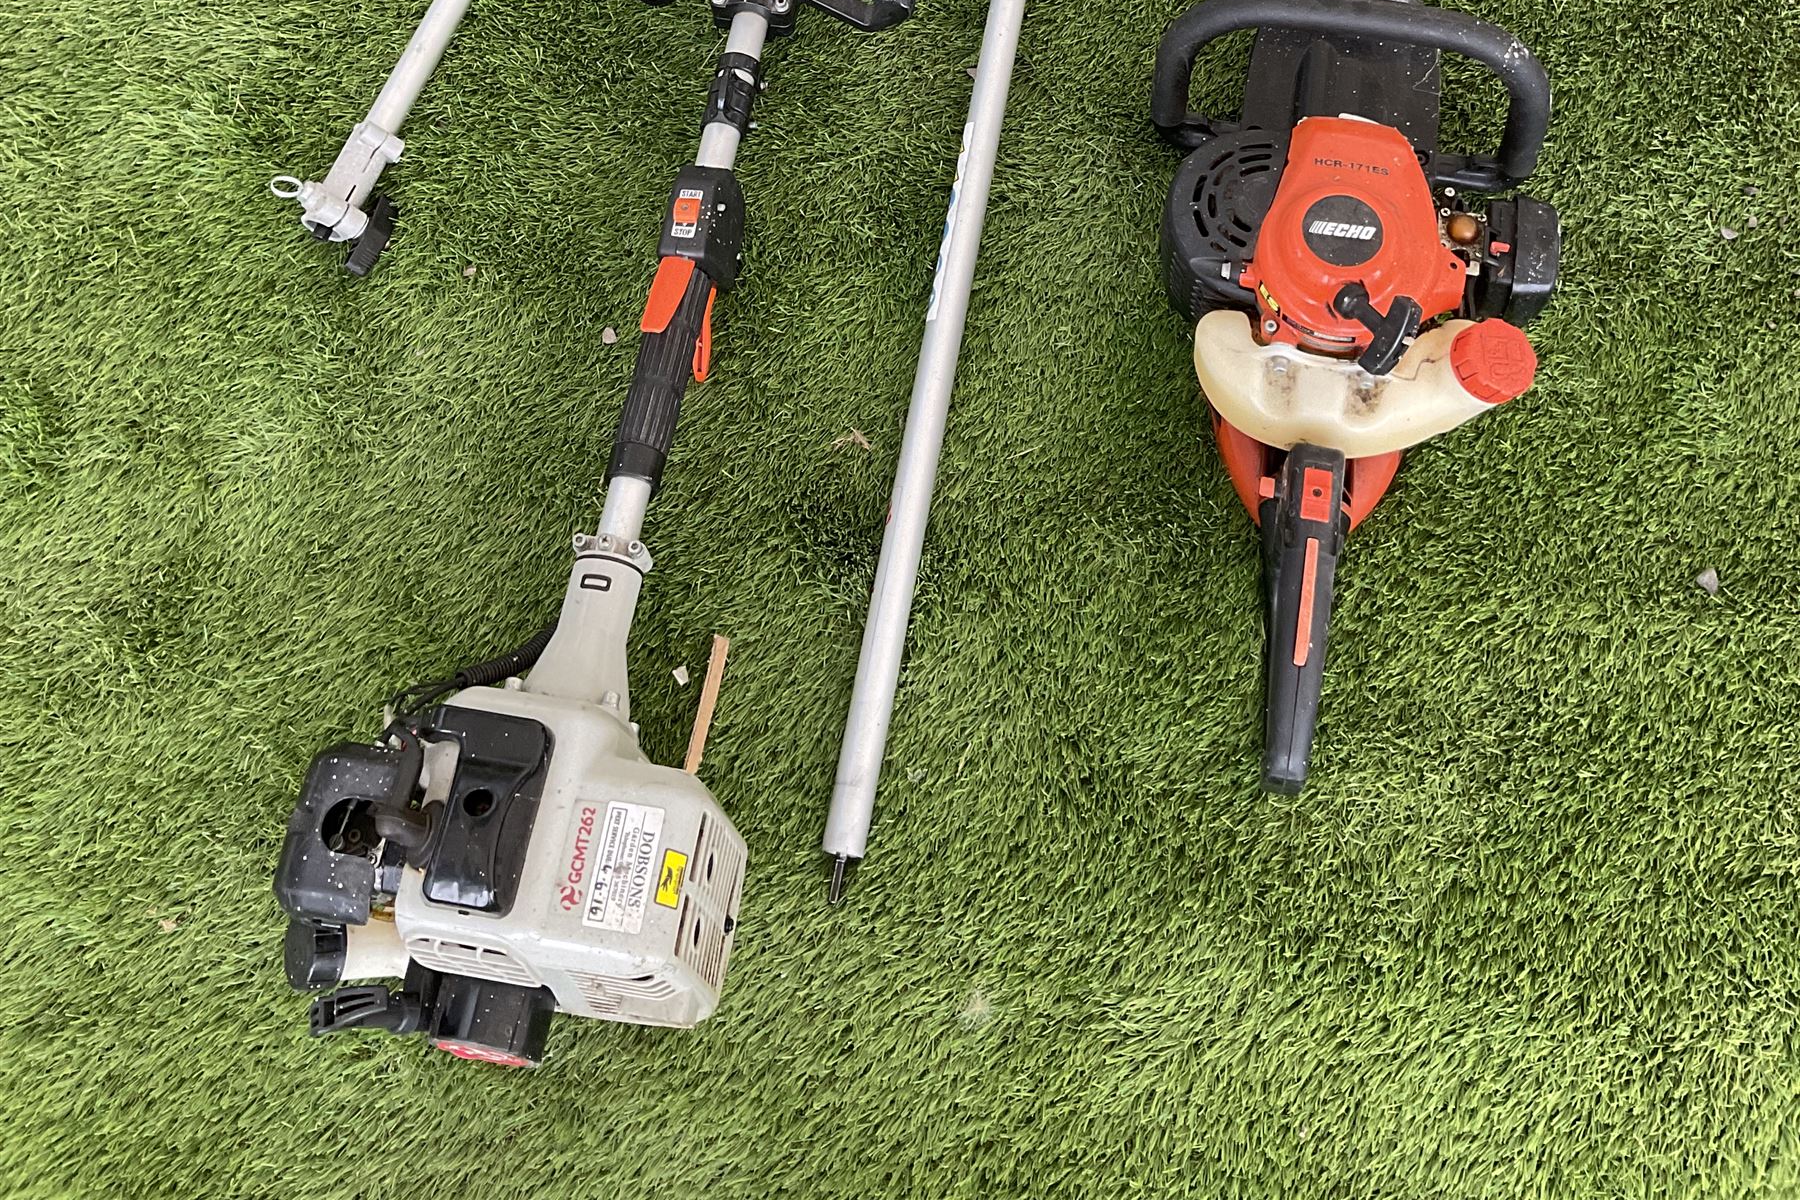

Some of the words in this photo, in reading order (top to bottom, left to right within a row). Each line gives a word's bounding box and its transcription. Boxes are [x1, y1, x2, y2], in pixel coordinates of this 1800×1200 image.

[1314, 158, 1389, 175] HCR-171ES
[681, 190, 701, 198] START
[673, 228, 692, 236] STOP
[1321, 222, 1376, 240] ECHO
[568, 807, 596, 884] GCMT262
[608, 825, 619, 848] SERVICE
[629, 827, 641, 858] Garden
[627, 830, 655, 908] DOBSONS
